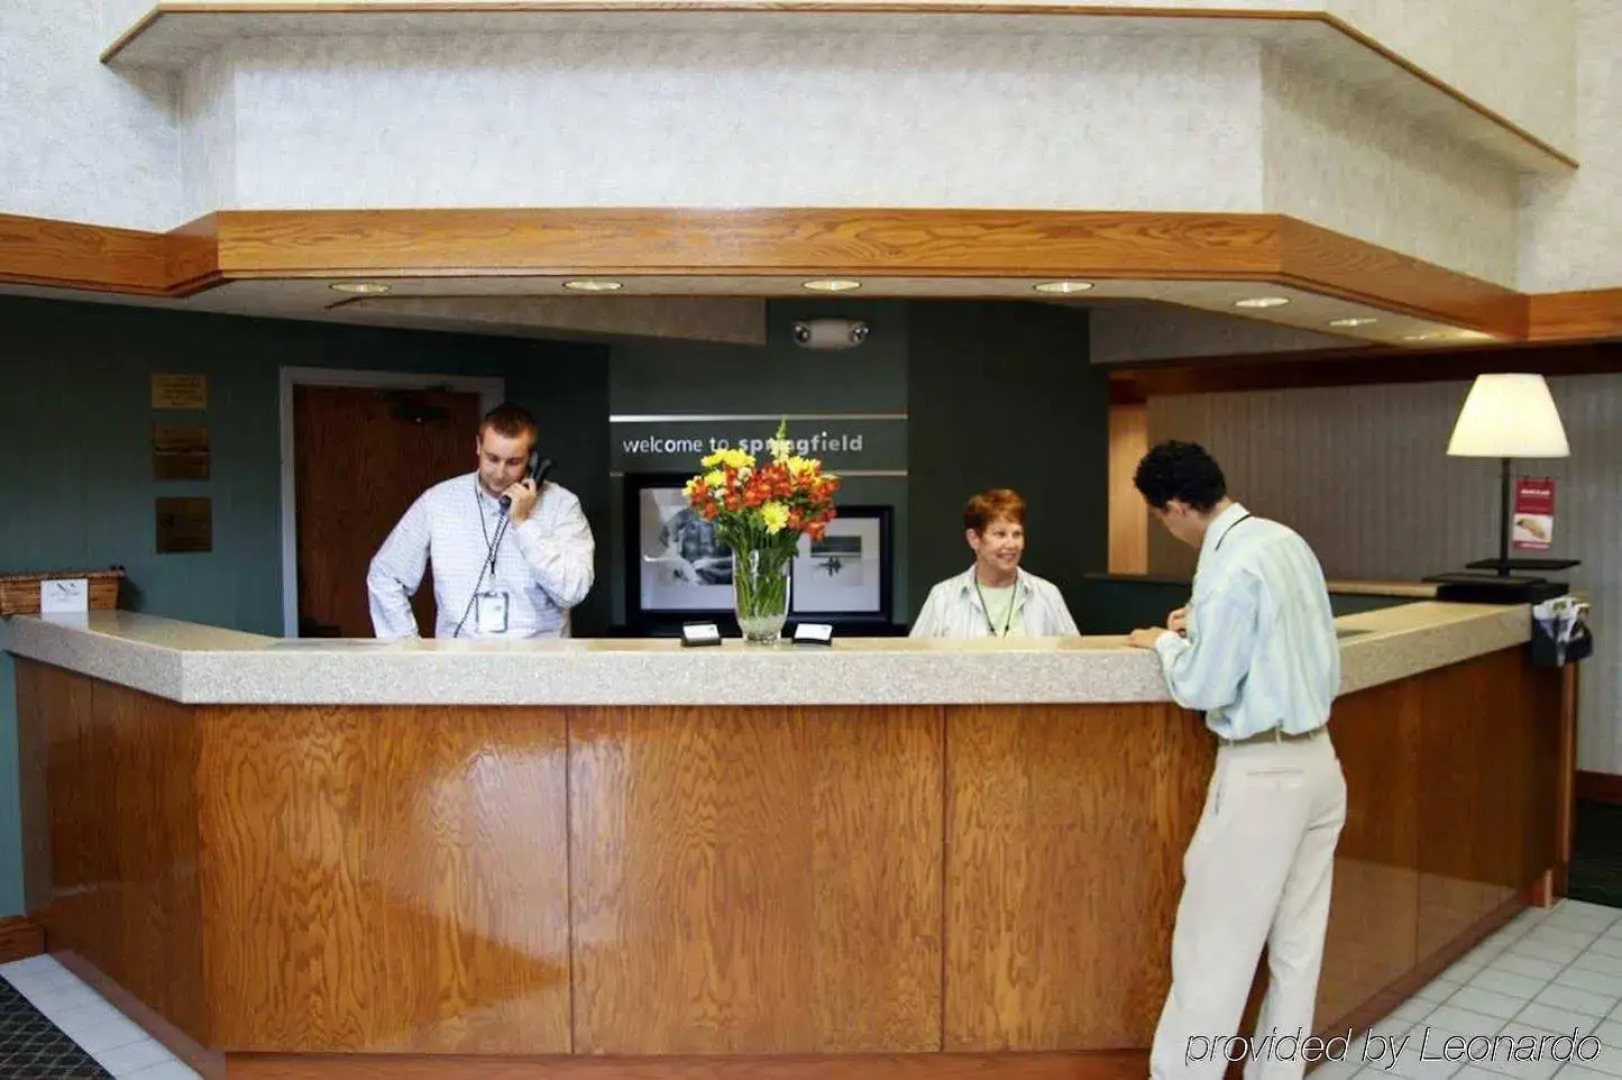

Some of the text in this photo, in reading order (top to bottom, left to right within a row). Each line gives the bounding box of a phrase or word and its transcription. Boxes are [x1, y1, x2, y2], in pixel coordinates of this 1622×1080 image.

[622, 431, 863, 455] welcome to sprngfield
